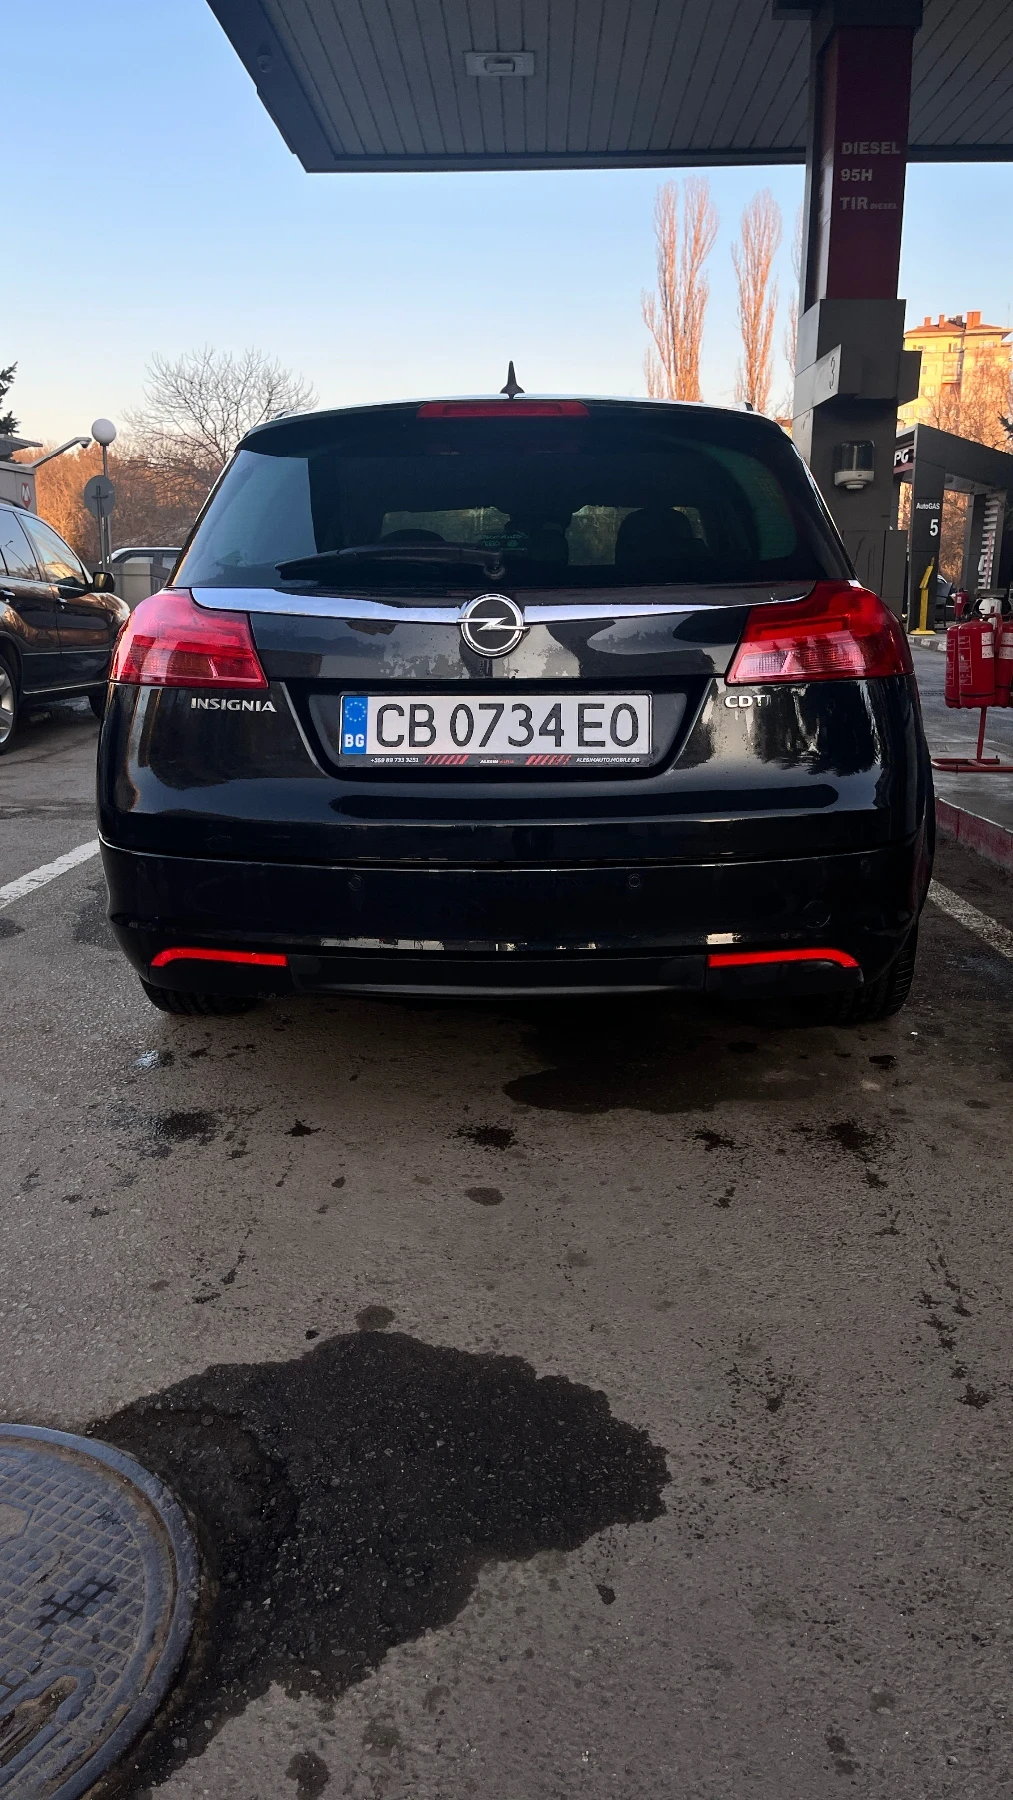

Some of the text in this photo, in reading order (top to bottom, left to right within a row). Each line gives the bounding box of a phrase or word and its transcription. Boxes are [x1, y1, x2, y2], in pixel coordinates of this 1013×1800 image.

[841, 142, 901, 155] DIESEL
[840, 168, 873, 182] 95H
[839, 196, 898, 211] TIR DIESEL
[893, 449, 909, 466] PG
[916, 502, 940, 510] AutoGAS
[929, 518, 939, 537] 5
[190, 697, 278, 713] INSIGNIA
[376, 703, 437, 748] CB
[450, 703, 565, 748] 0734
[344, 733, 365, 748] BG
